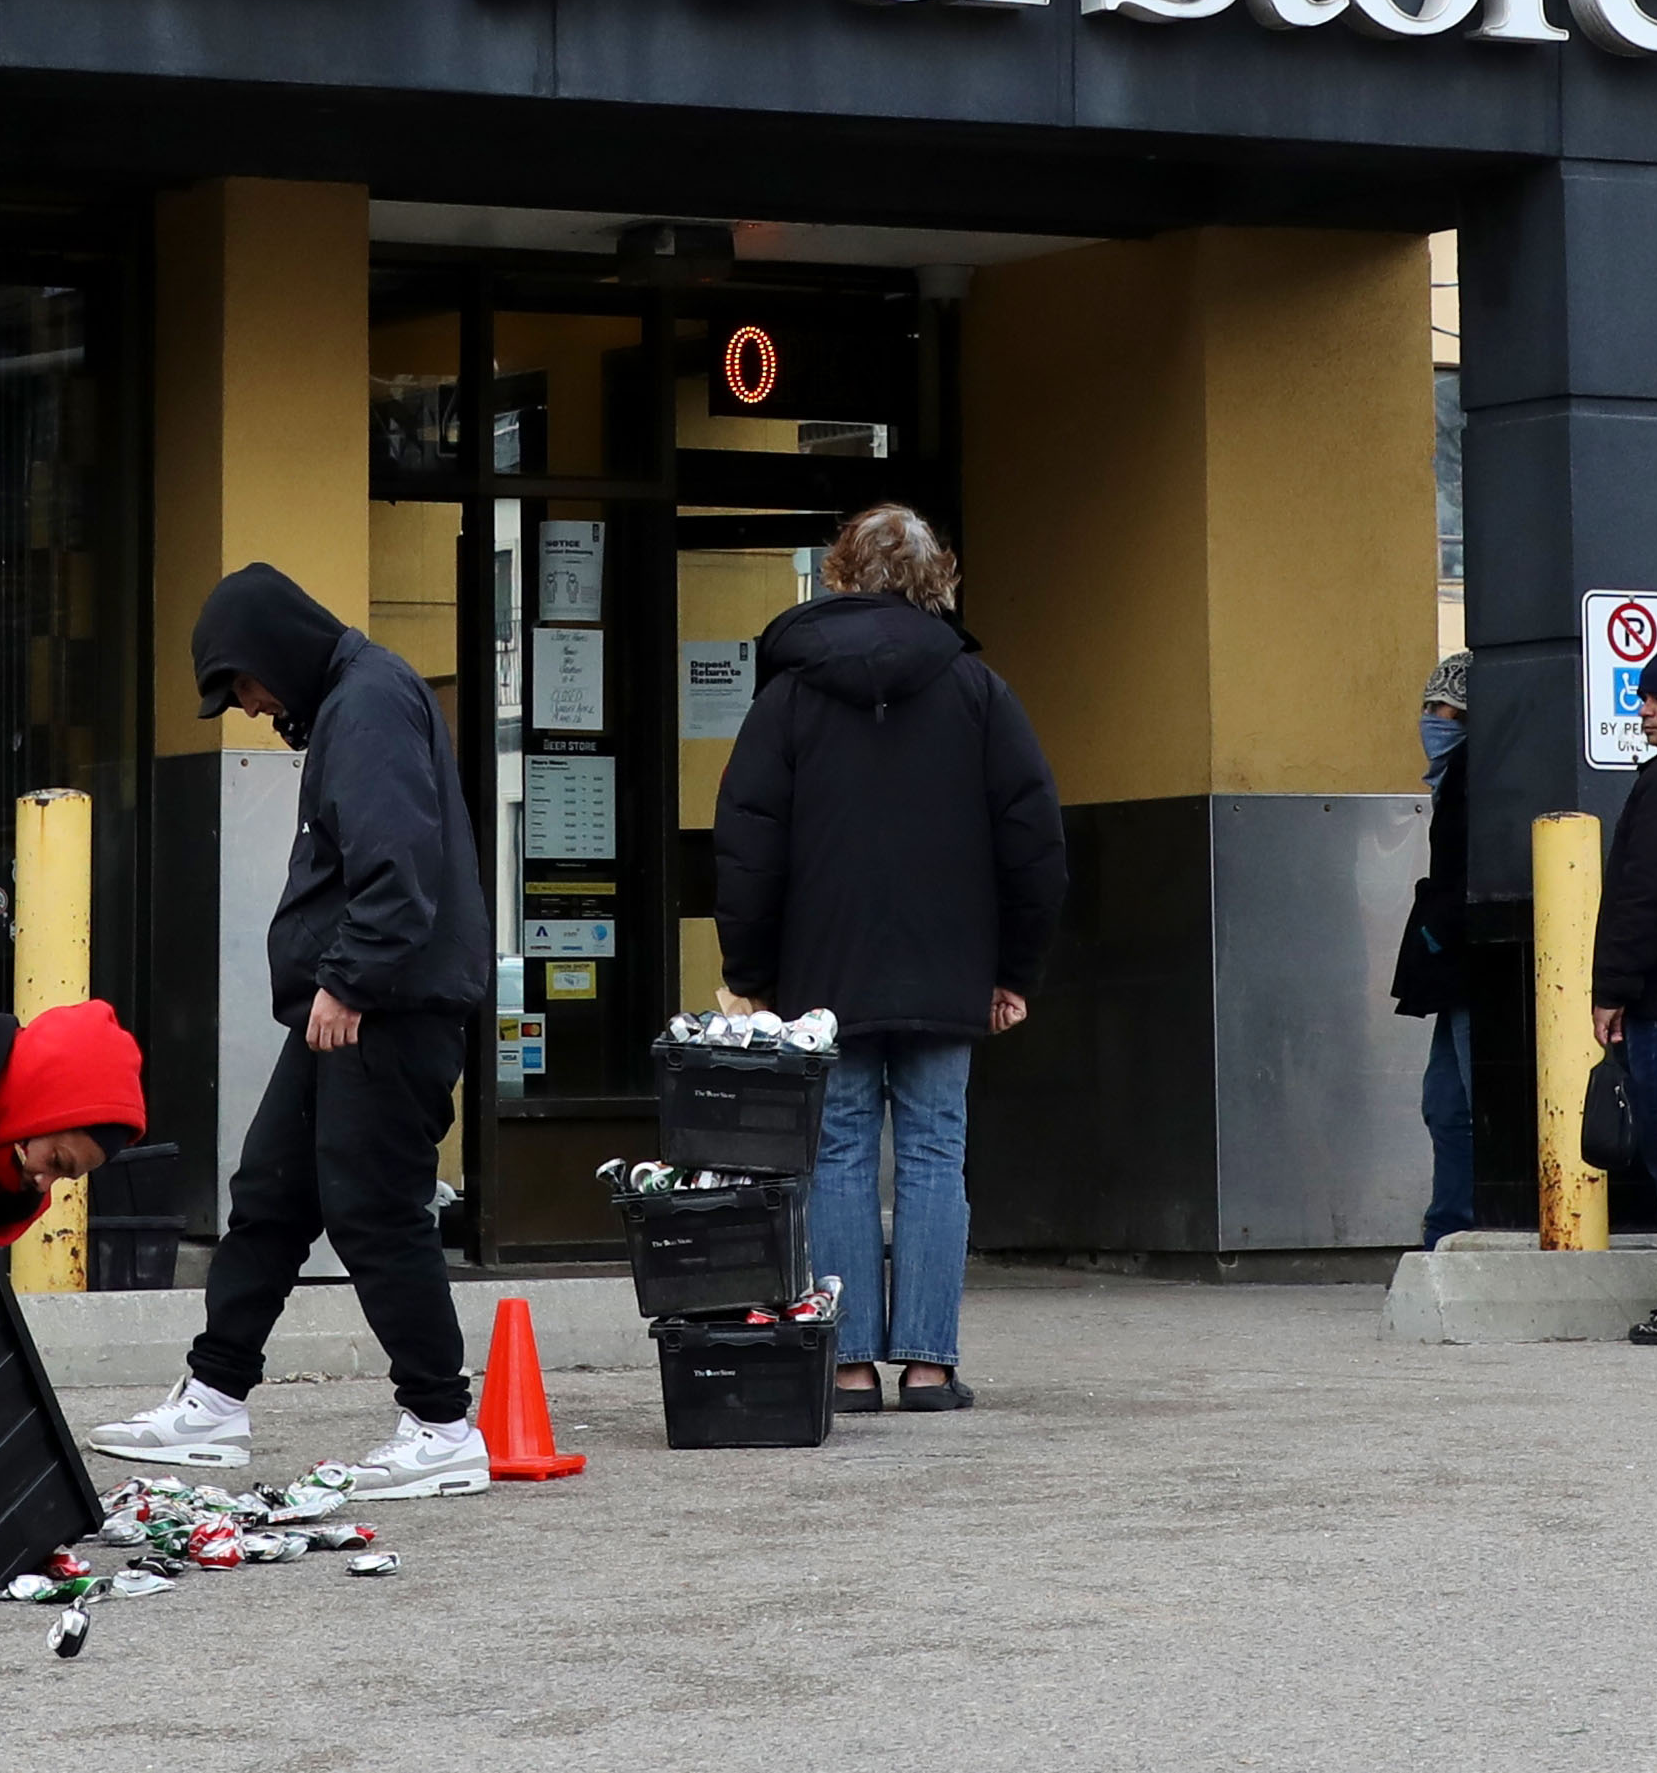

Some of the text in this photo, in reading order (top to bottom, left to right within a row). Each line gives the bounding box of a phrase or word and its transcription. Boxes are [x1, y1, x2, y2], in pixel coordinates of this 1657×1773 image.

[545, 540, 581, 548] NOTICE
[690, 660, 731, 671] Deposit
[690, 668, 742, 677] Return to
[690, 677, 734, 685] Resume
[1600, 722, 1617, 735] BY
[568, 741, 597, 751] STORE
